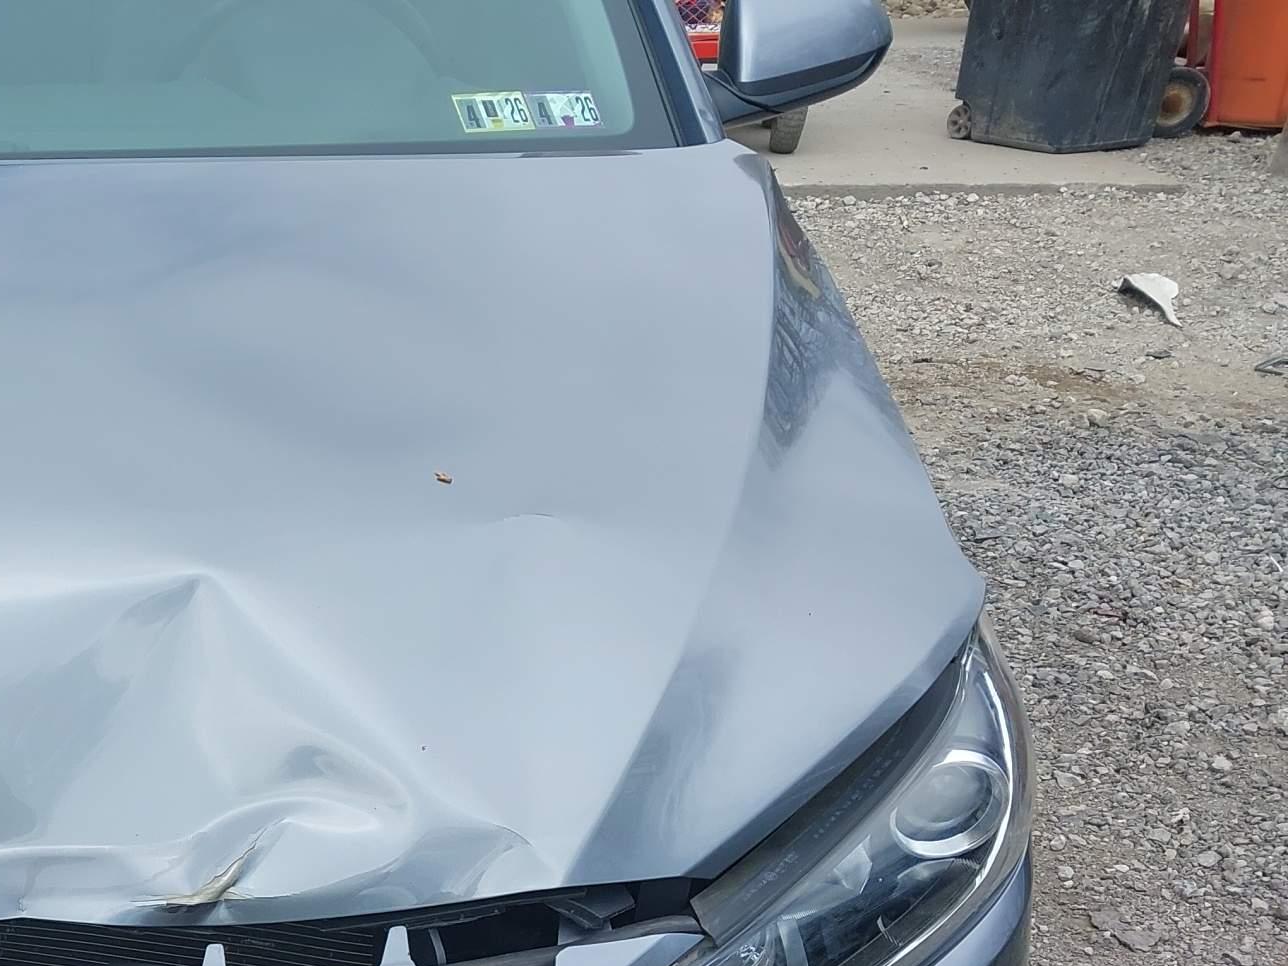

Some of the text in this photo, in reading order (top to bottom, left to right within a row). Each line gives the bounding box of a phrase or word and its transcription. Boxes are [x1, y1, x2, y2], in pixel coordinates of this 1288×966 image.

[466, 97, 529, 128] 4 26
[538, 96, 599, 125] 4 26
